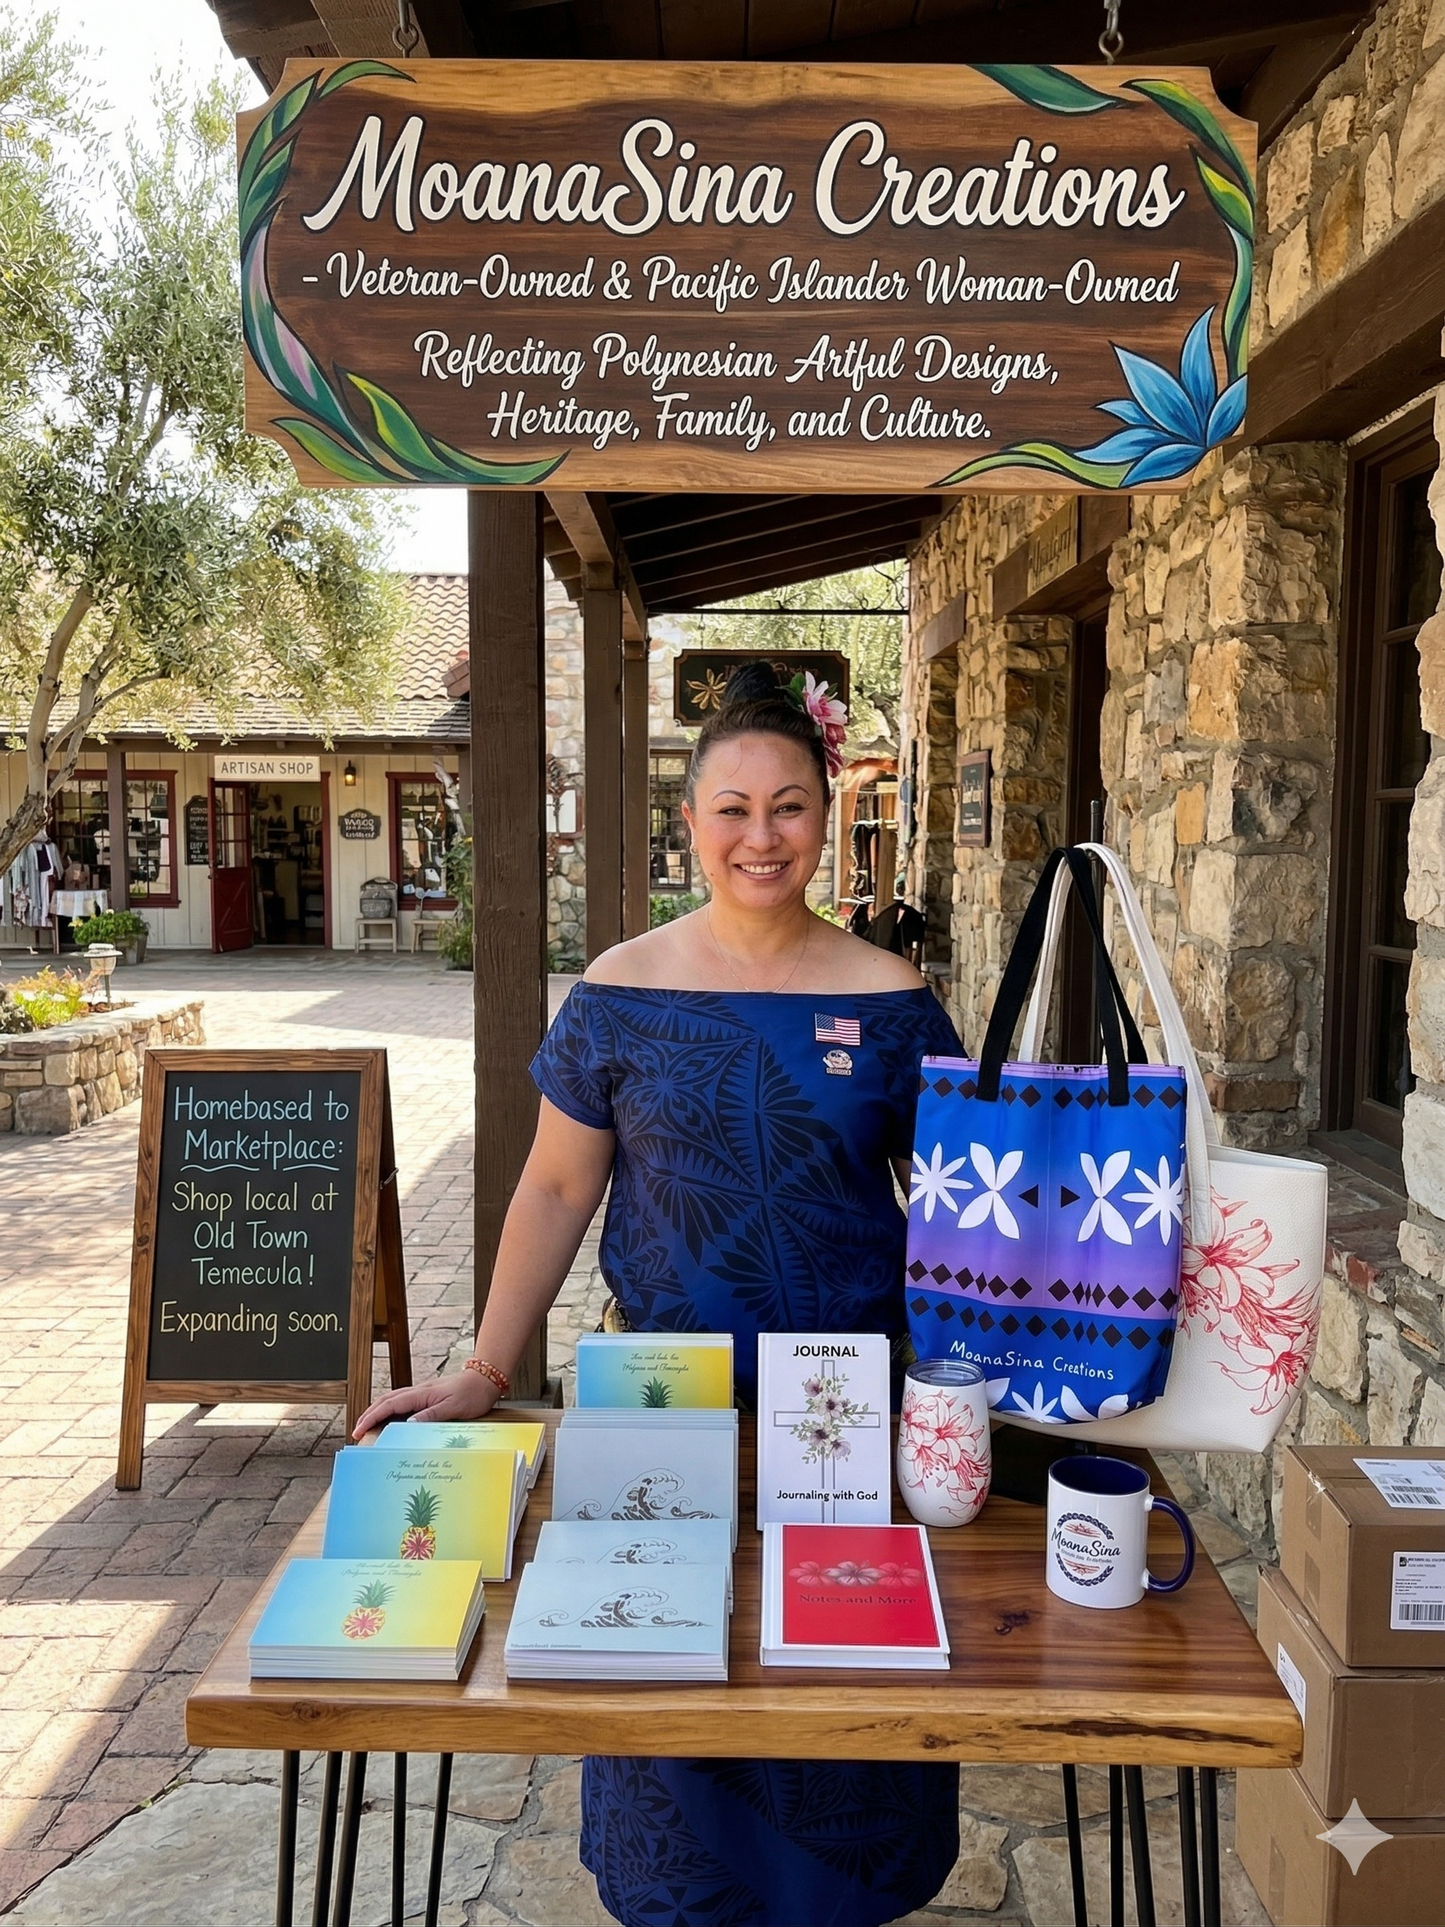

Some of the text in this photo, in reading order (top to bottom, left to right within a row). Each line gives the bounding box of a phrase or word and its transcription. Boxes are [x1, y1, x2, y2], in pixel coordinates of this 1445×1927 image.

[302, 114, 1186, 236] MoanaSina Creations
[326, 249, 595, 300] Veteran-Owned
[603, 260, 633, 300] &
[642, 255, 759, 313] Pacific
[767, 256, 909, 304] Islander
[916, 256, 1180, 305] Woman-Owned
[414, 330, 1060, 395] Reflecting Polynesian Artful Designs,
[487, 391, 993, 451] Heritage, Family, and Culture.
[221, 762, 314, 774] ARTISAN SHOP
[174, 1086, 349, 1121] Homebased to
[184, 1128, 343, 1170] Marketplace:
[171, 1181, 339, 1222] Shop local at
[193, 1220, 308, 1249] Old Town
[191, 1254, 314, 1286] Temecula!
[160, 1300, 343, 1347] Expanding soon.
[792, 1345, 860, 1357] JOURNAL
[949, 1340, 1114, 1380] MoanaSina Creations
[776, 1490, 878, 1502] Journaling with God
[1051, 1527, 1121, 1557] MoanaSina
[800, 1594, 917, 1605] Notes and More
